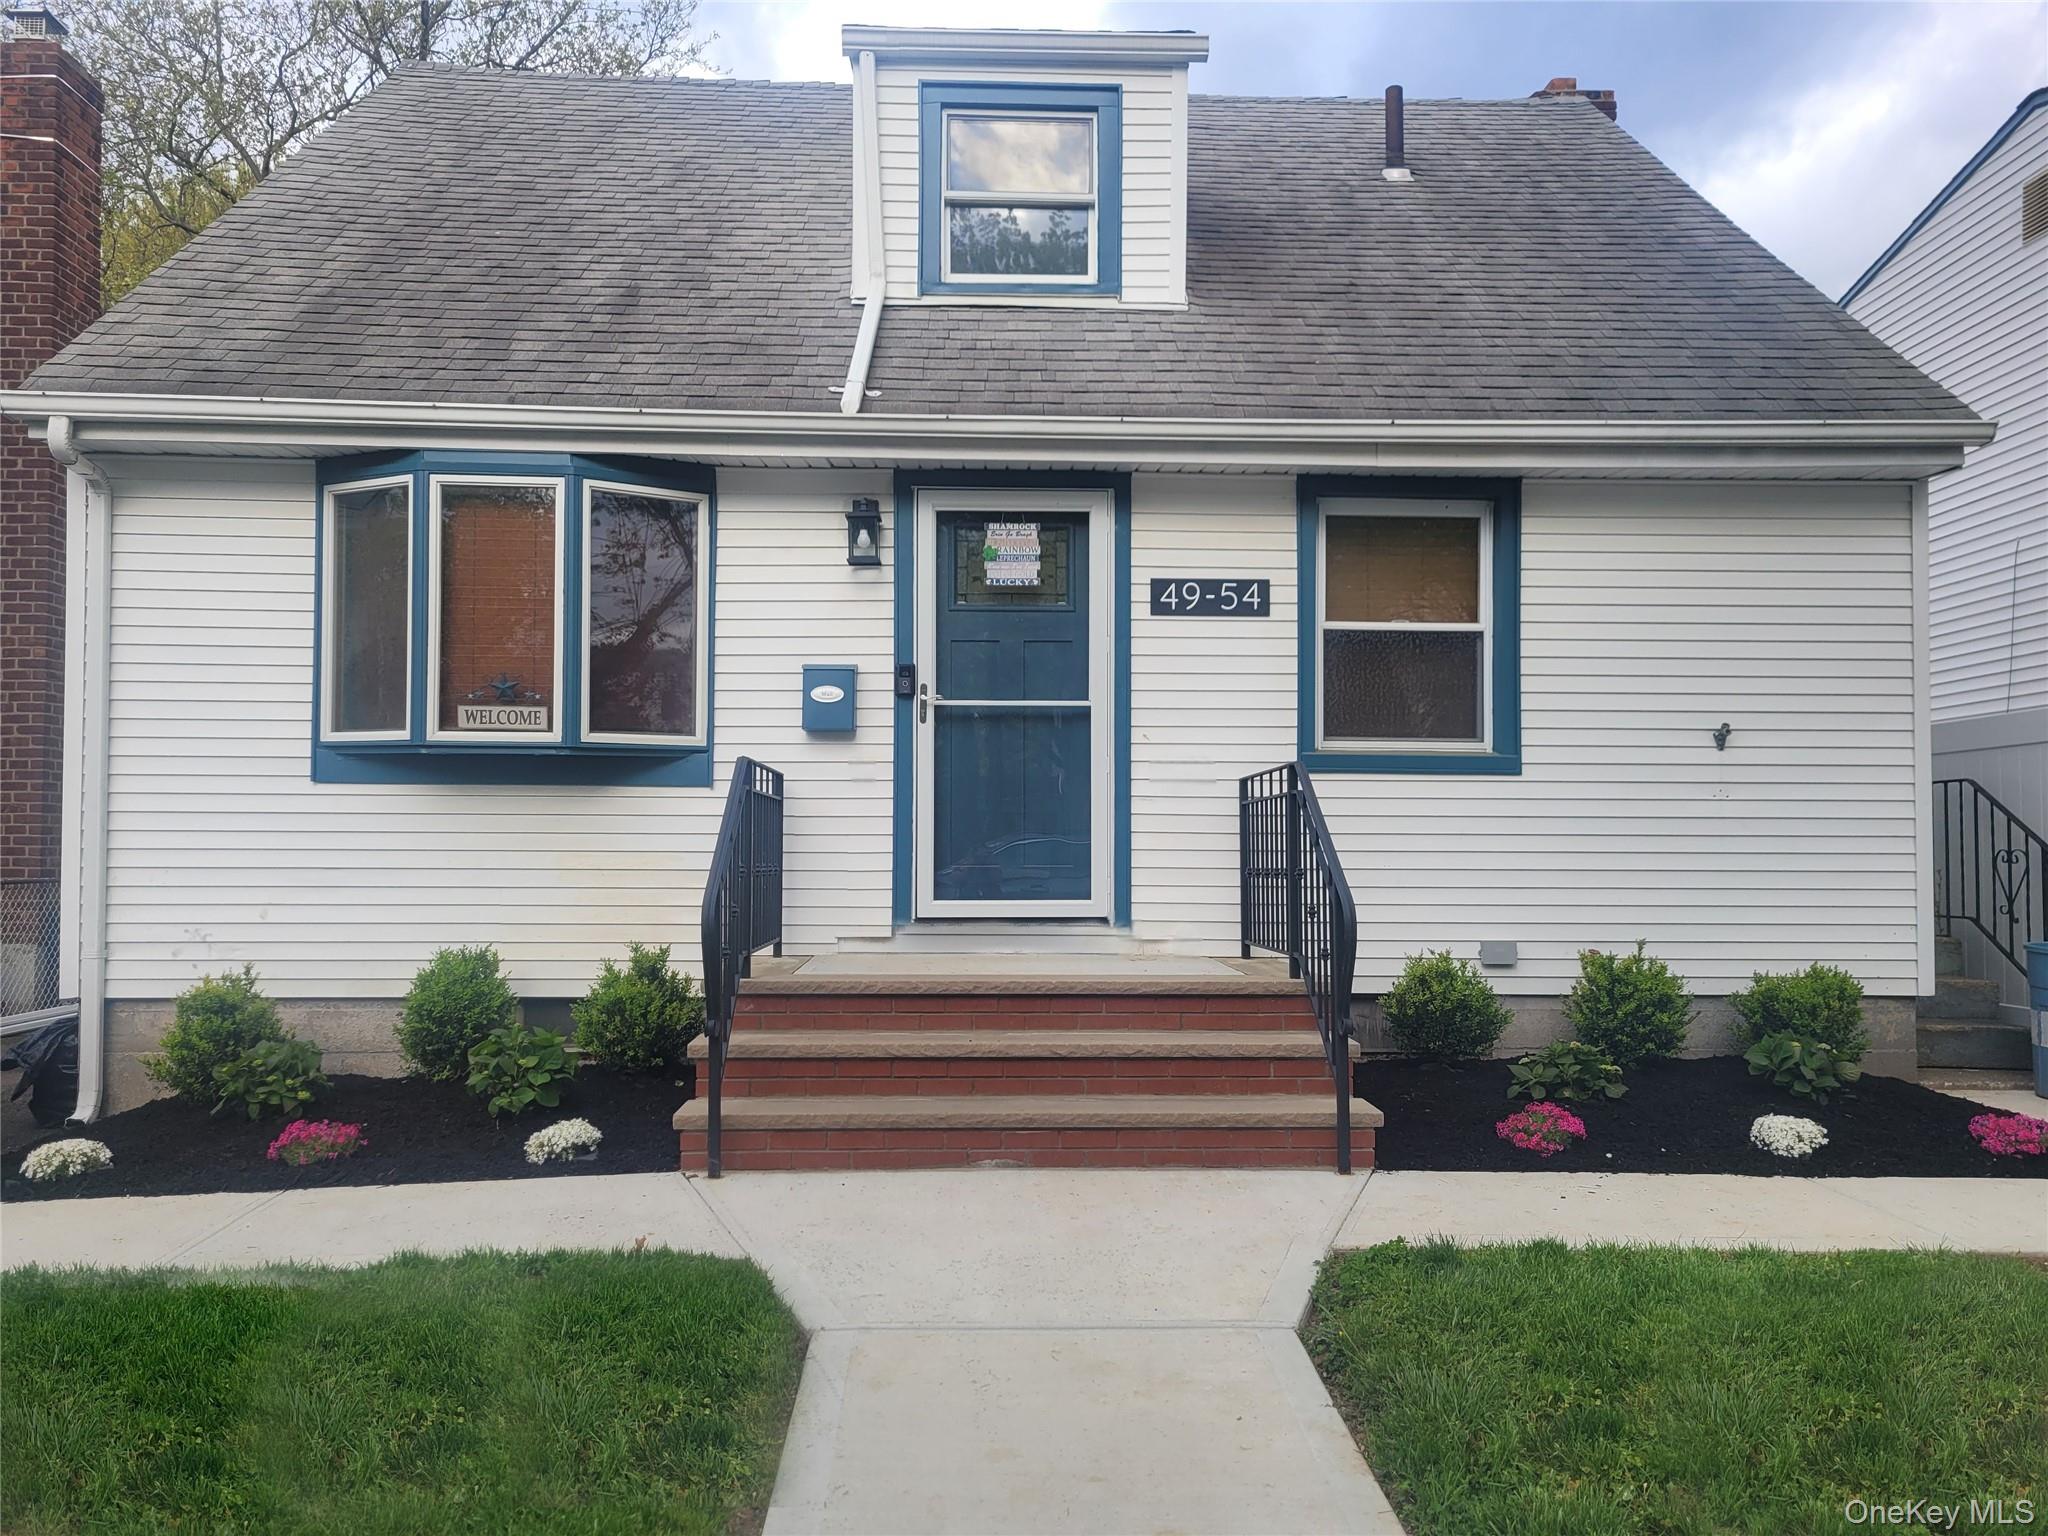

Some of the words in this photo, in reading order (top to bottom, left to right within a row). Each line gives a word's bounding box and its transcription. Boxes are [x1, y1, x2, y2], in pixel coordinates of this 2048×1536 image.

[988, 522, 1037, 530] SHAMROCK
[997, 546, 1039, 554] RAINBOW
[993, 578, 1030, 586] LUCKY
[1160, 582, 1261, 611] 49-54
[464, 709, 542, 725] WELCOME
